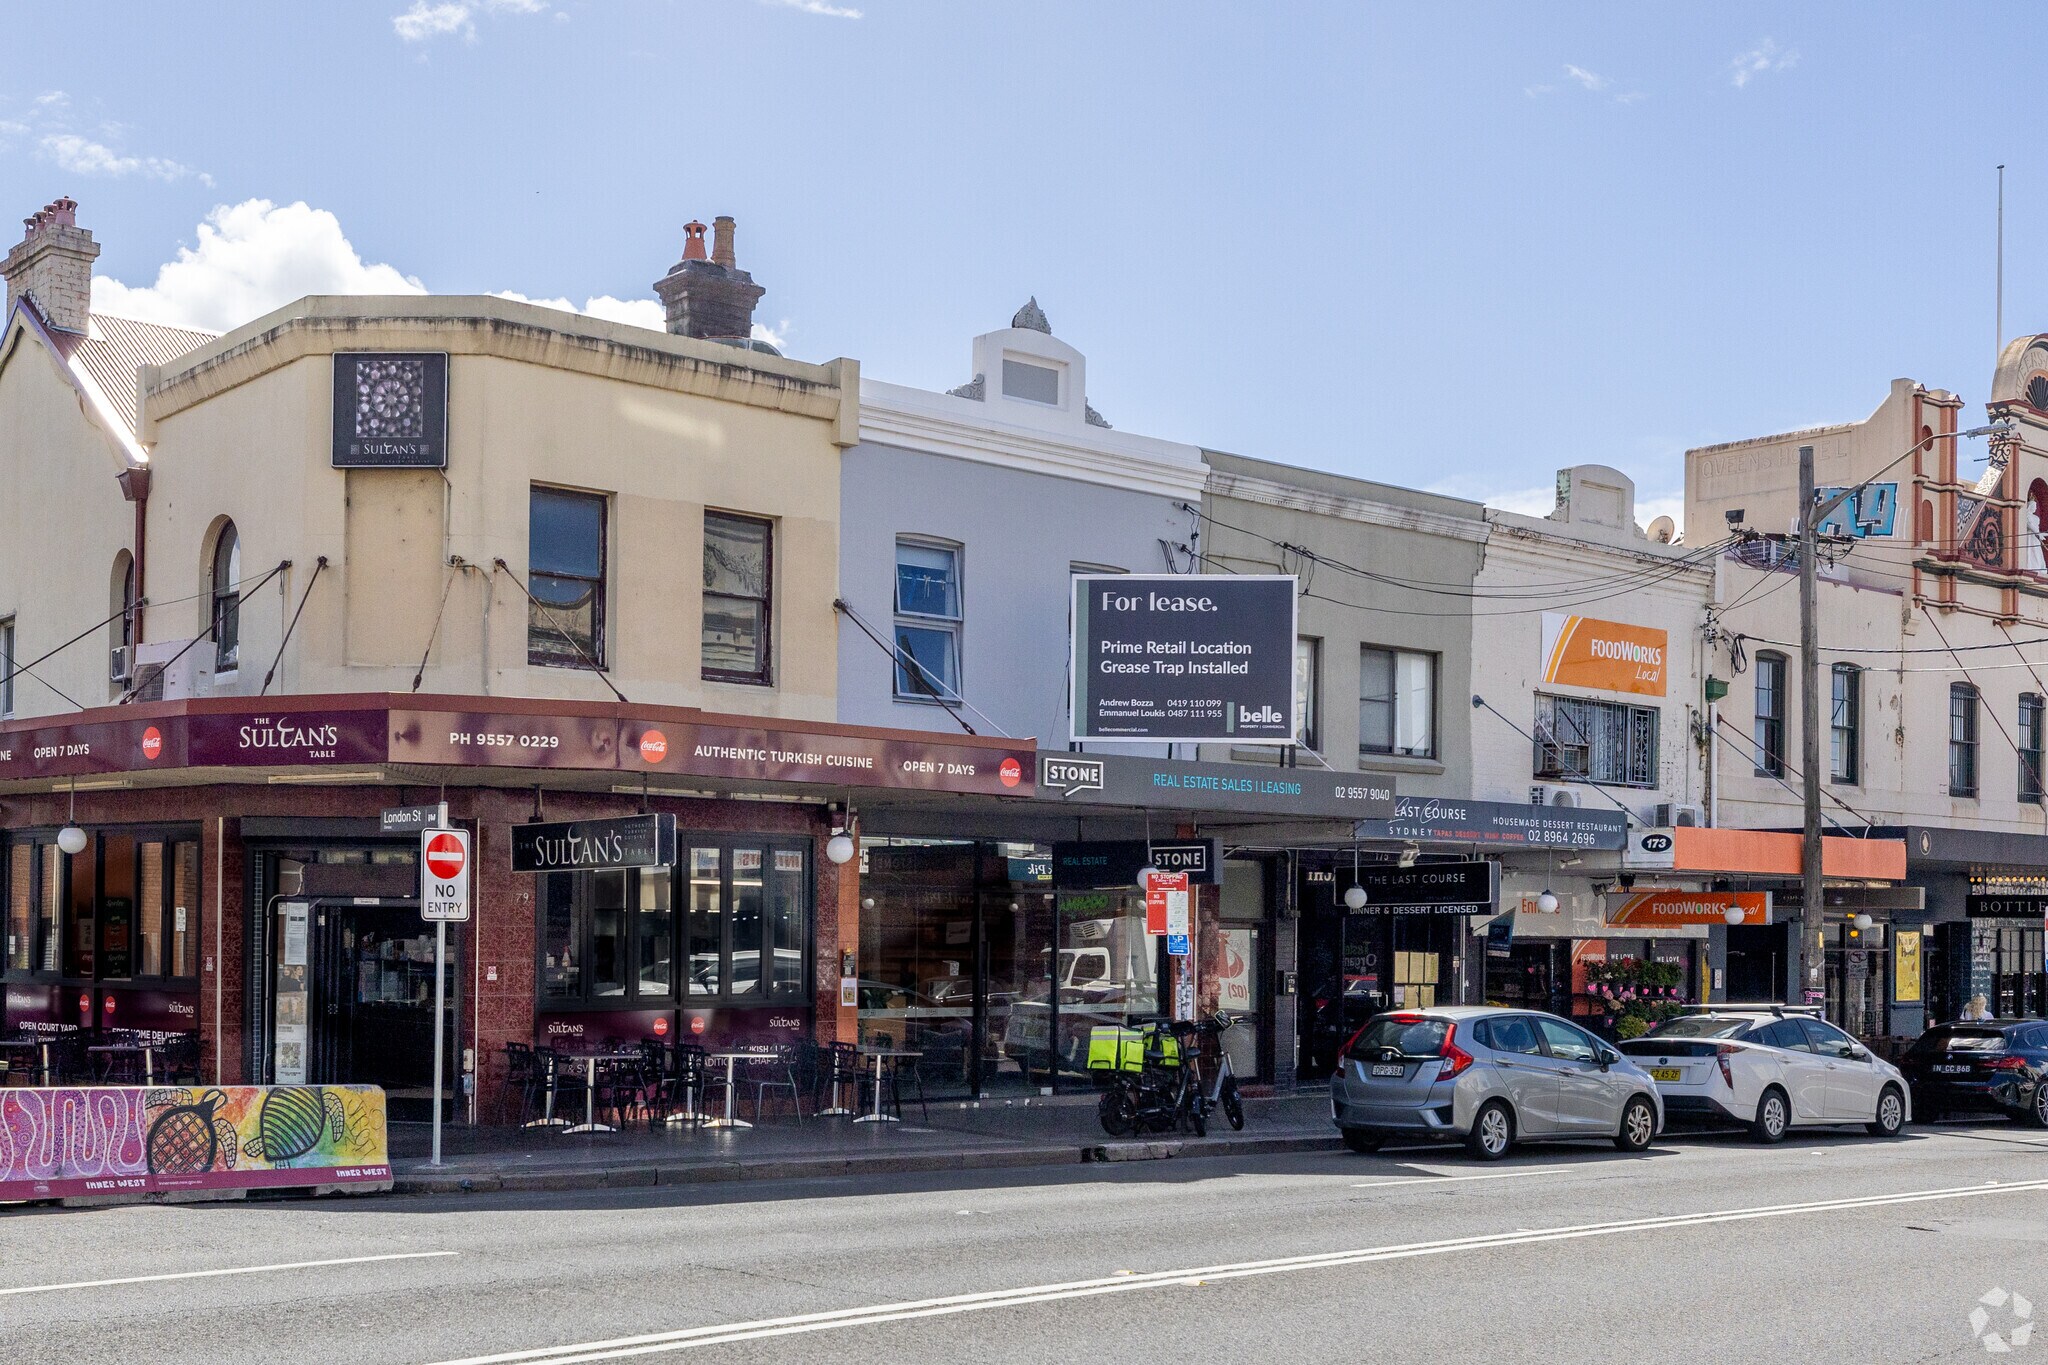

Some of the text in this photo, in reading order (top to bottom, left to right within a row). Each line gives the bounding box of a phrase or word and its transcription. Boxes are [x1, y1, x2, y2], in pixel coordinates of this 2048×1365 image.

[363, 442, 416, 455] SULTAN'S
[1102, 591, 1218, 612] For lease.
[1101, 640, 1252, 655] Prime Retail Location
[1100, 660, 1249, 677] Grease Trap Installed
[1634, 664, 1661, 683] Local
[1099, 699, 1222, 708] Andrew Bozza 0419 110 099
[254, 717, 270, 725] THE
[1099, 709, 1223, 719] Emmanuel Loukis 0487 111 955
[1240, 705, 1283, 723] belle
[239, 716, 338, 748] SULTAN'S
[449, 733, 559, 748] PH 9557 0229
[34, 746, 57, 759] OPEN
[59, 745, 65, 757] 7
[67, 743, 90, 756] DAYS
[309, 750, 336, 758] TABLE
[694, 744, 873, 769] AUTHENTIC TURKISH CUISINE
[903, 760, 975, 776] OPEN 7 DAYS
[1050, 765, 1099, 782] STONE
[1153, 773, 1181, 787] REAL
[1183, 775, 1219, 790] ESTATE
[1221, 778, 1253, 792] SALES
[1260, 781, 1301, 795] LEASING
[1334, 786, 1390, 801] 02 9557 9040
[383, 809, 421, 824] London St
[1419, 799, 1467, 823] COURSE
[1492, 816, 1622, 833] HOUSEMADE DESSERT RESTAURANT
[1388, 826, 1433, 837] SYDNEY
[1433, 828, 1453, 838] TAPAS
[1528, 829, 1595, 845] 02 8964 2696
[535, 823, 623, 866] SULTAN'S
[1647, 838, 1667, 849] 173
[624, 847, 655, 856] TABLE
[1063, 856, 1108, 866] REAL ESTATE
[1155, 852, 1201, 866] STONE
[1368, 873, 1466, 885] THE LAST COURSE
[435, 884, 456, 898] NO
[427, 902, 463, 913] ENTRY
[1350, 905, 1478, 915] DINNER & DESSERT LICENSED
[1652, 901, 1726, 915] FOODWORKS
[1980, 901, 2046, 913] BOTTLE
[19, 1021, 37, 1030] OPEN
[37, 1022, 60, 1032] COURT
[547, 1021, 584, 1034] SULTAN'S
[336, 1167, 387, 1177] INNER WEST
[86, 1178, 146, 1189] INNER WEST
